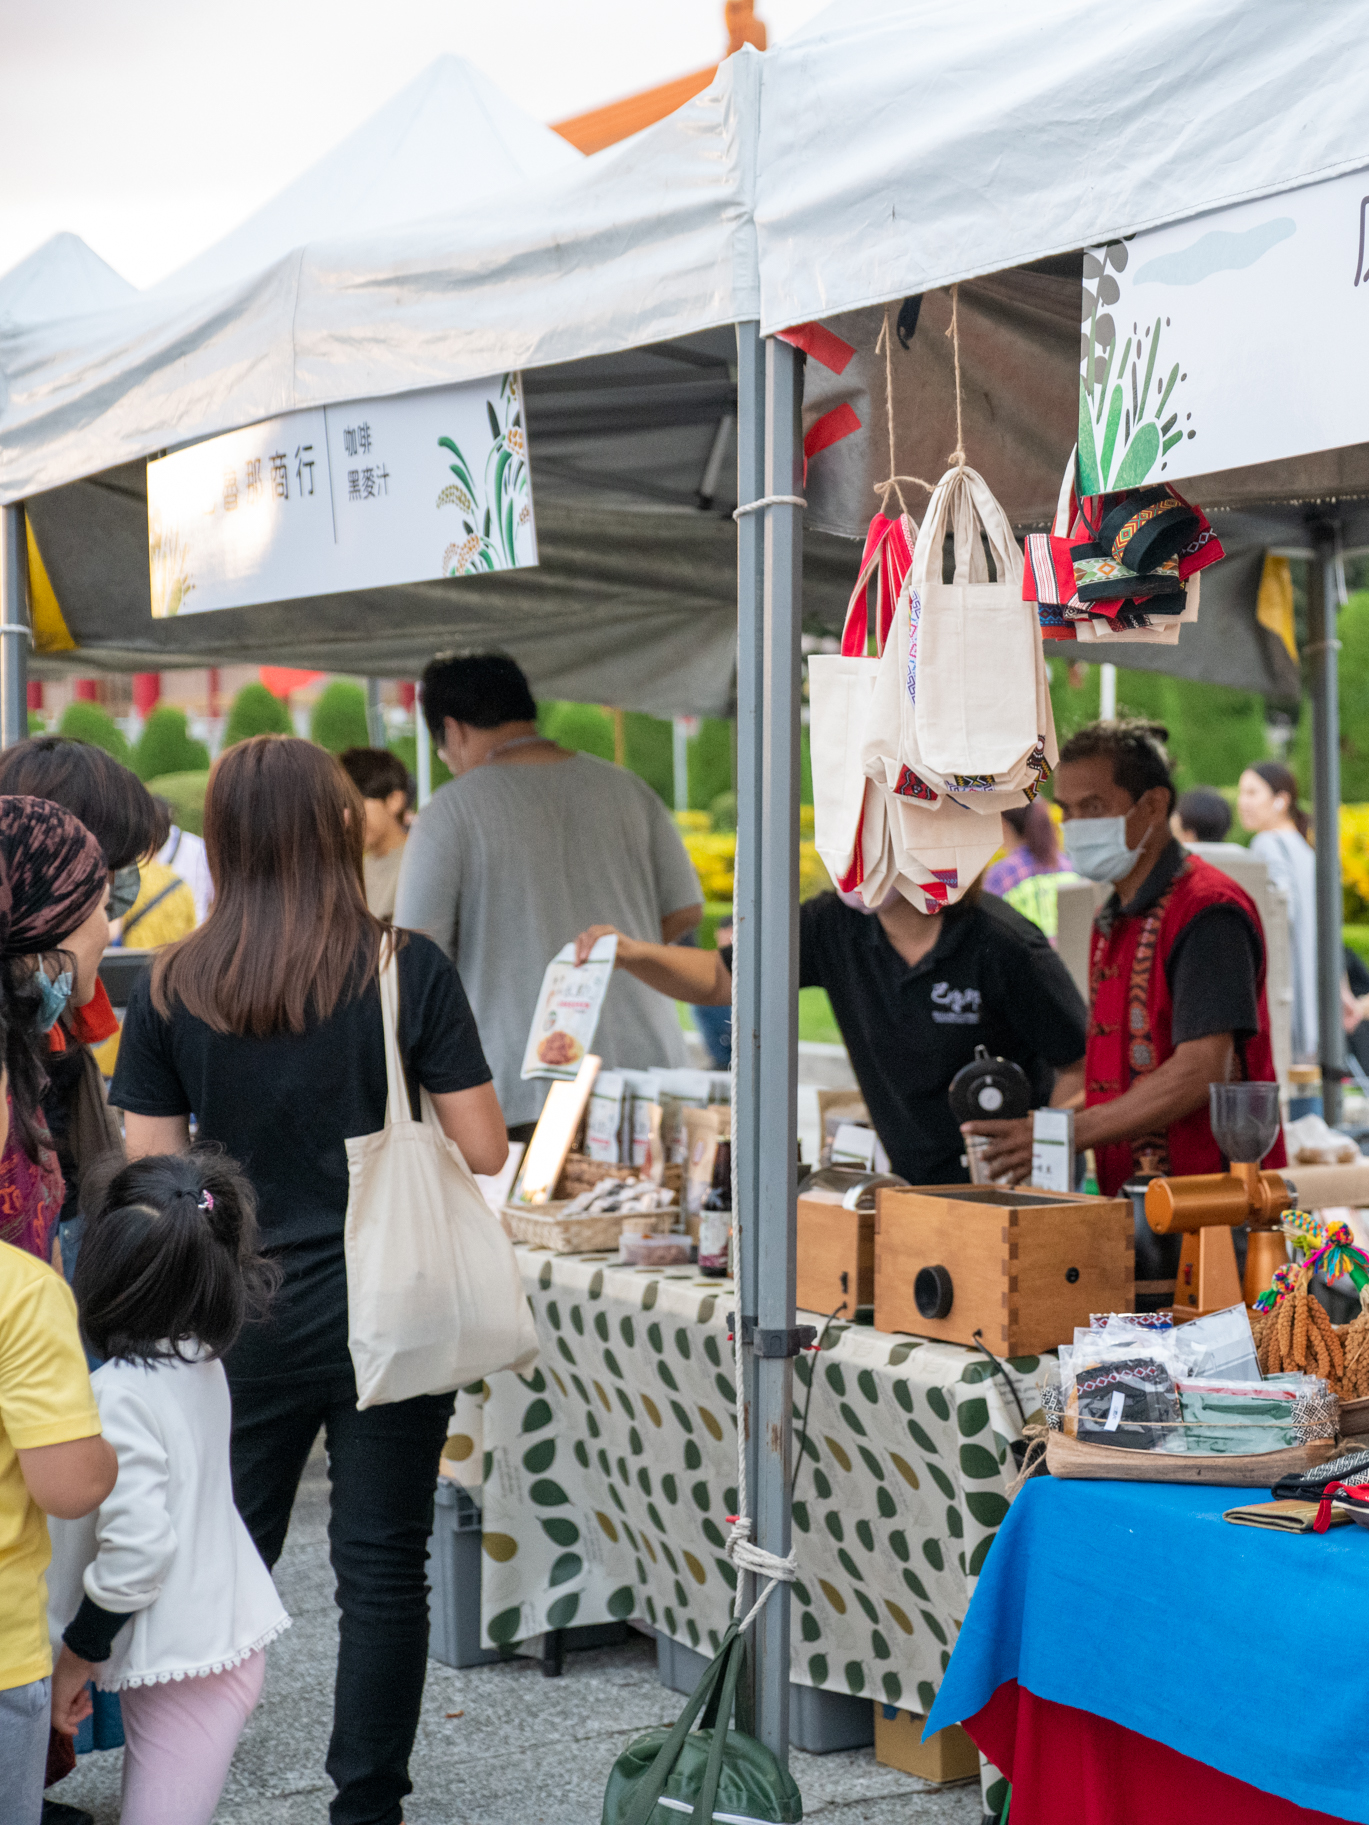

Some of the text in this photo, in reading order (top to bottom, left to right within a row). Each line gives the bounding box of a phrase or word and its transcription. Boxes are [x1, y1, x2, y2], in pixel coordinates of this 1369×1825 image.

[343, 421, 372, 456] 咖啡
[347, 462, 390, 501] 黑麥汁
